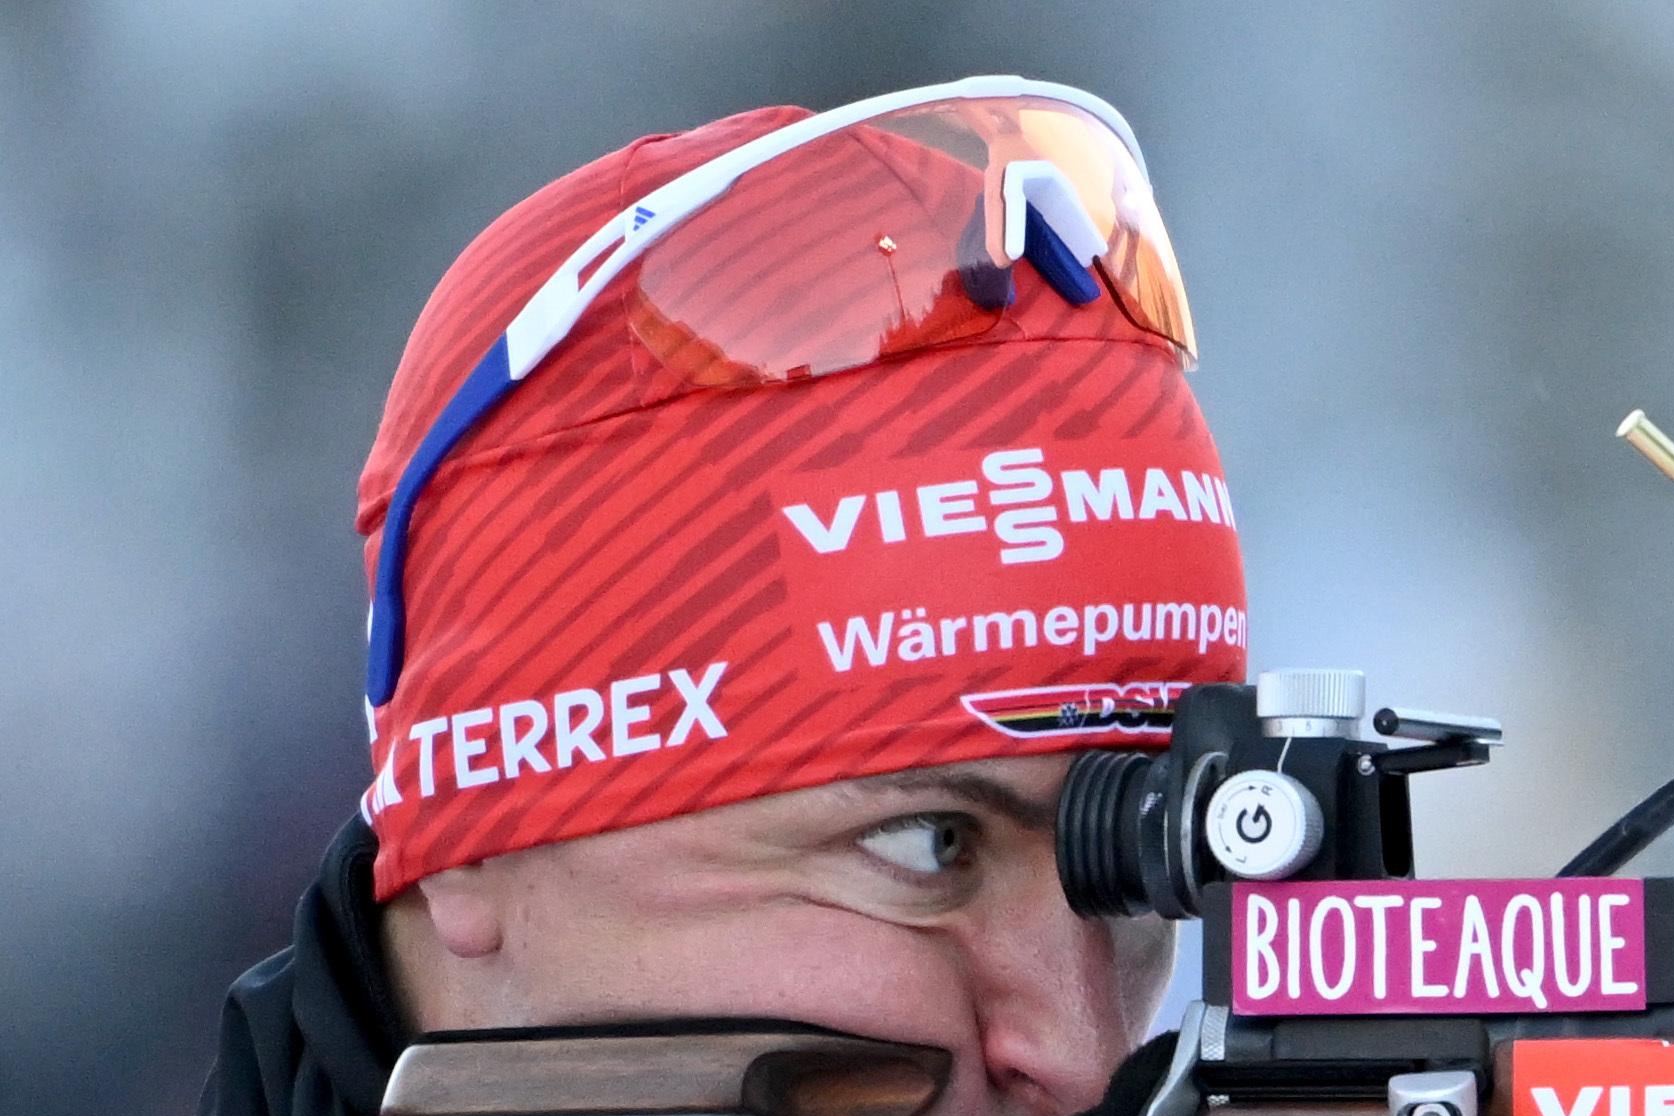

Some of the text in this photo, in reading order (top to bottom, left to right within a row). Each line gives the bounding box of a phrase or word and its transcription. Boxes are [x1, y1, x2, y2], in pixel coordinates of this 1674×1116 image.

[782, 448, 1237, 564] VIESSMANN
[817, 602, 1246, 672] Wärmepumpen
[409, 661, 728, 798] TERREX
[1246, 892, 1638, 1008] BIOTEAQUE
